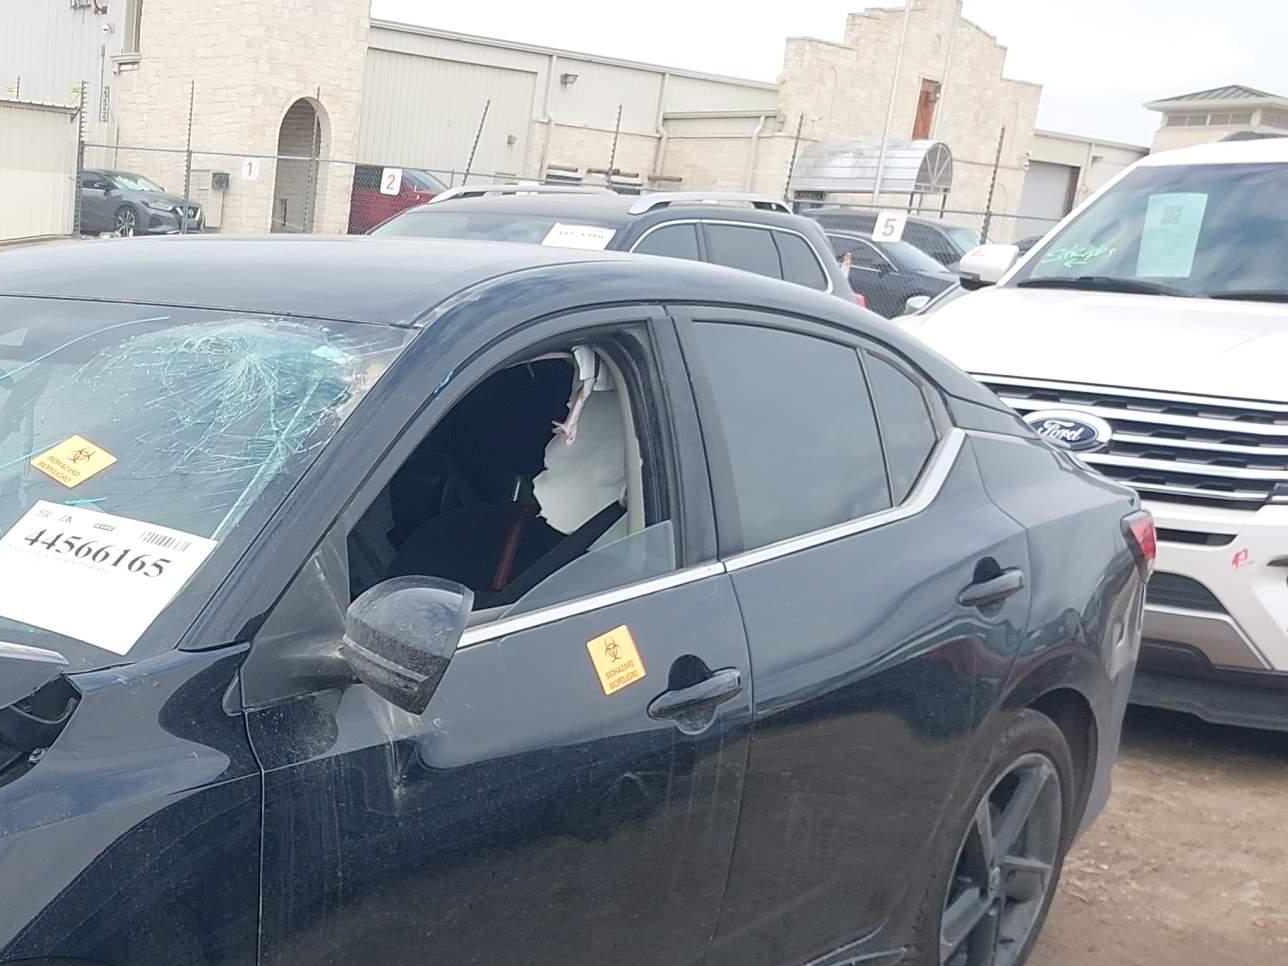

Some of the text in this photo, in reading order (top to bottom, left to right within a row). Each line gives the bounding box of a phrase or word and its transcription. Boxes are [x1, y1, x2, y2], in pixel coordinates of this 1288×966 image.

[246, 162, 254, 177] 1
[385, 174, 397, 191] 2
[881, 218, 897, 237] 5
[1038, 419, 1085, 441] Ford
[24, 528, 172, 578] 44566165
